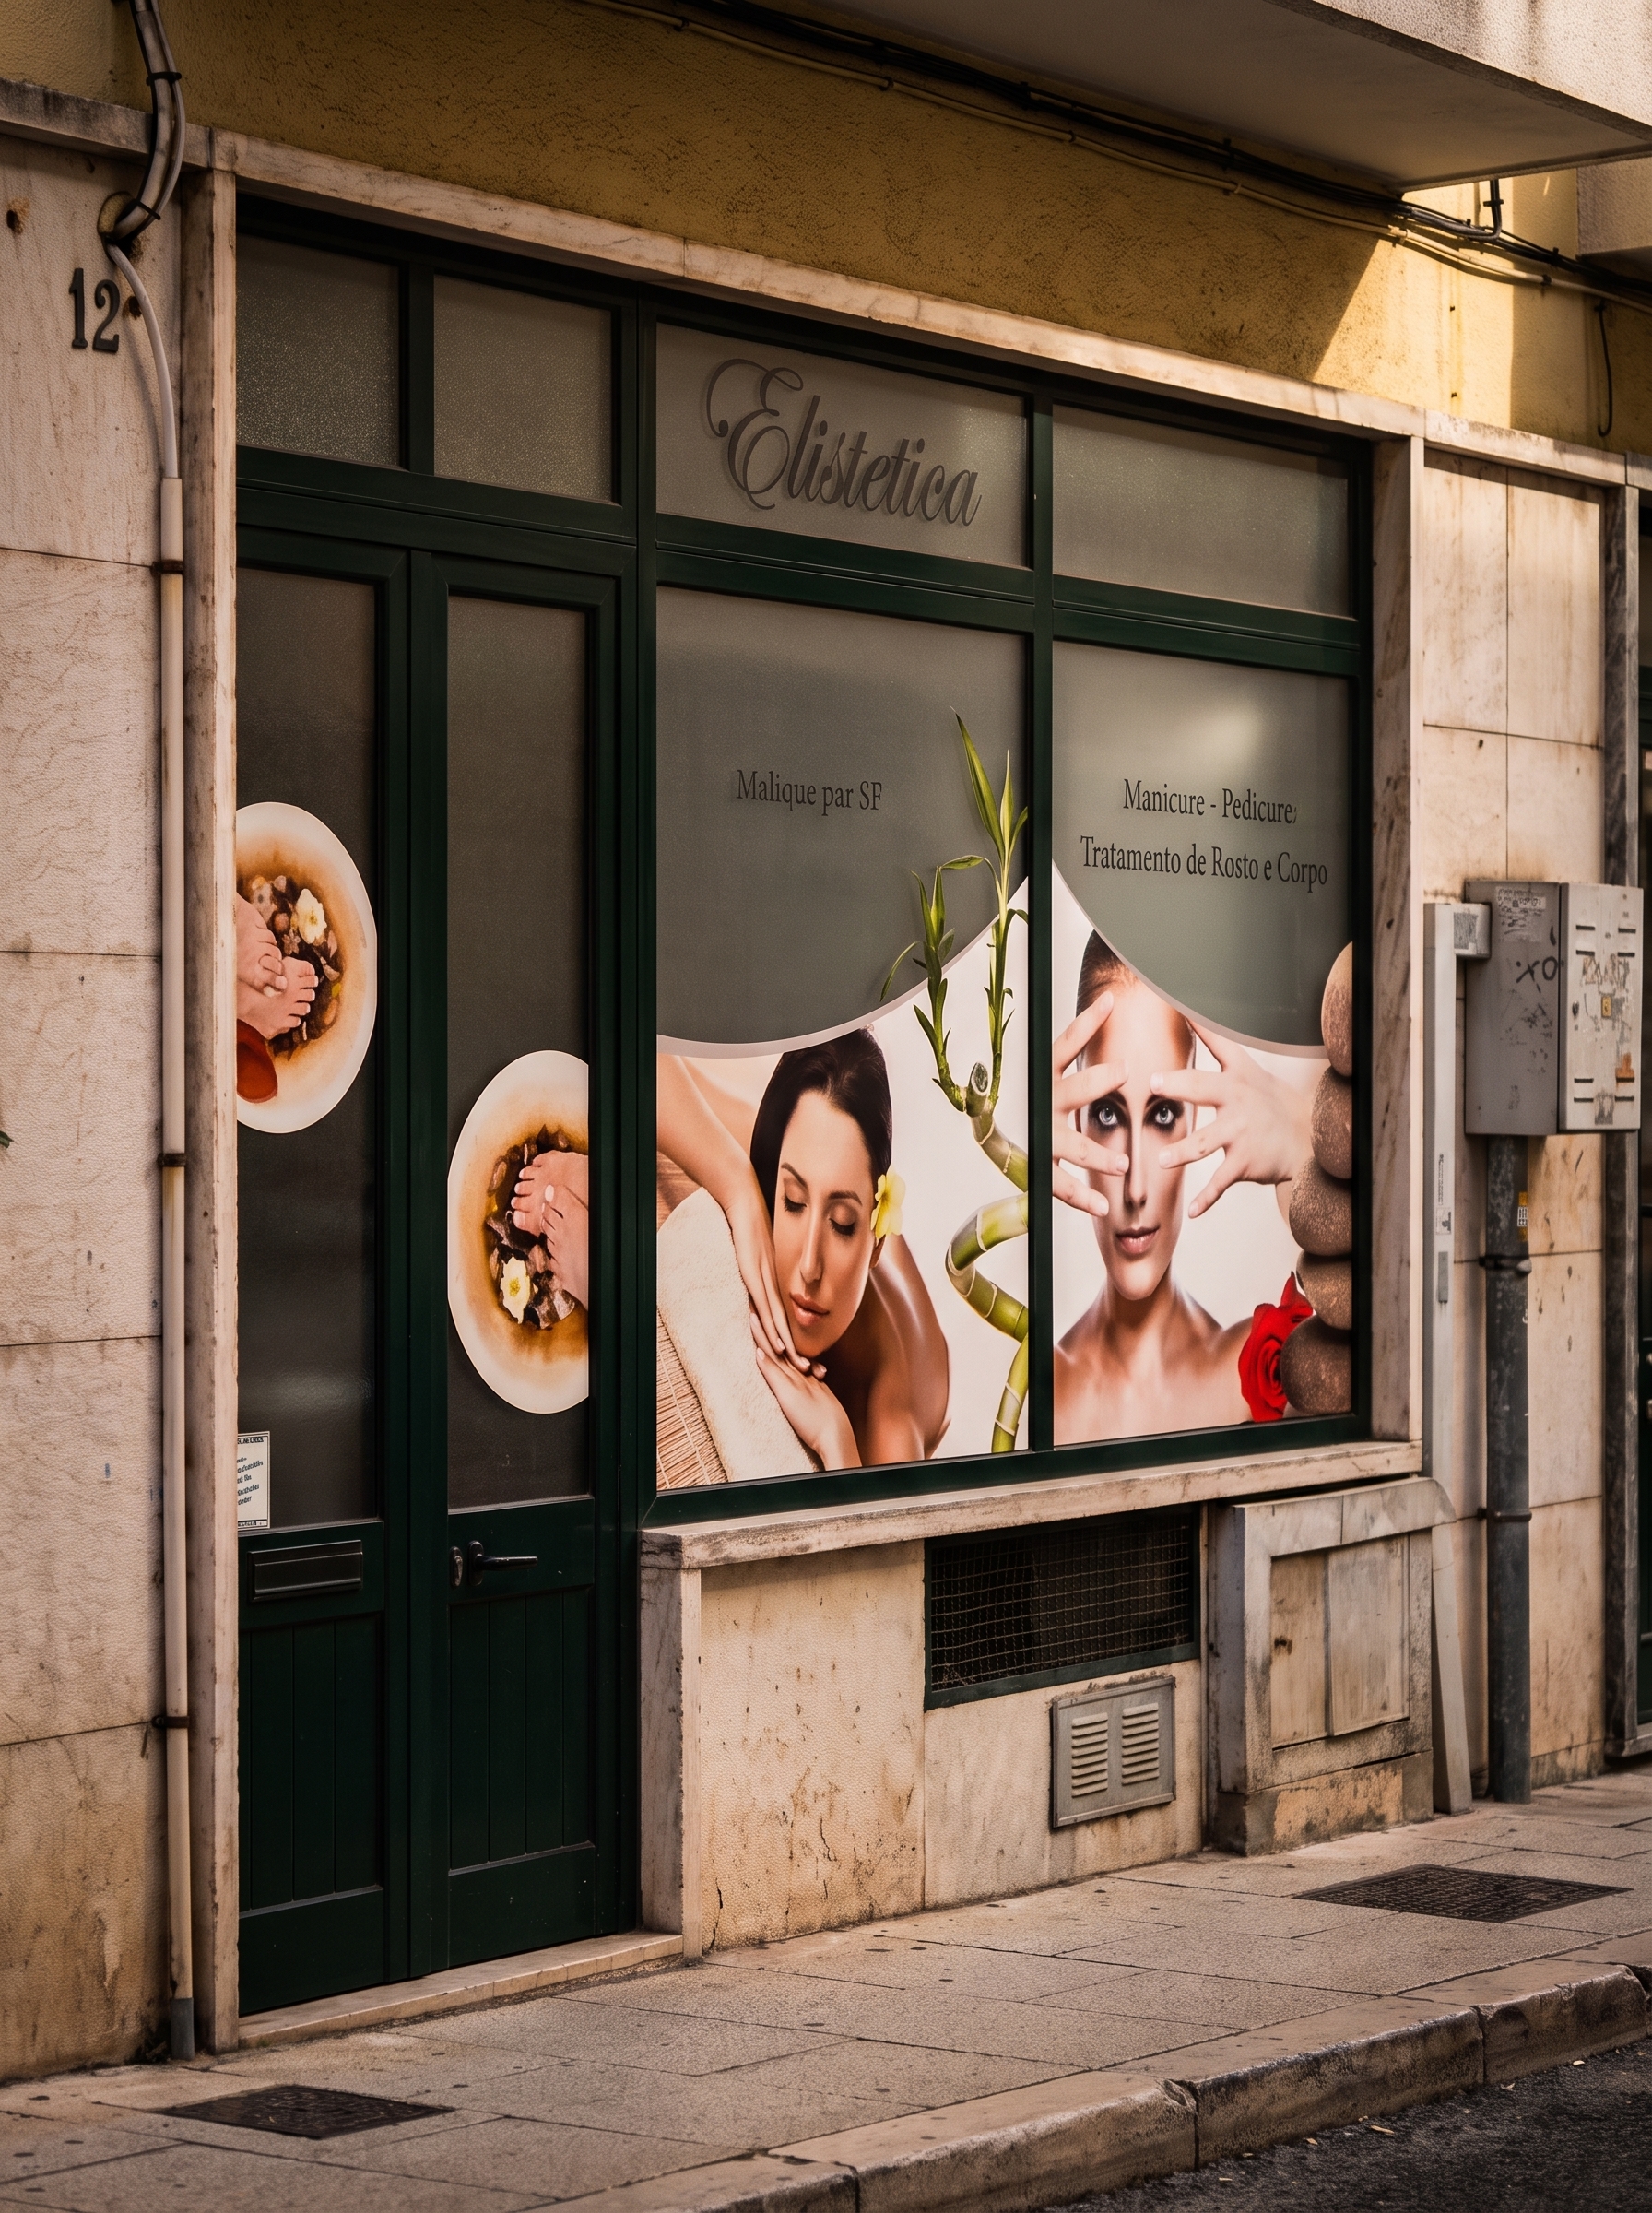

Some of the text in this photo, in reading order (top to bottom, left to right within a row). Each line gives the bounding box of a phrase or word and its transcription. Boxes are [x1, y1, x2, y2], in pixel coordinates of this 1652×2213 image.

[68, 267, 121, 355] 12
[706, 358, 983, 527] Elistetica
[736, 769, 882, 817] Malique par SF
[1123, 778, 1206, 816] Manicure
[1080, 834, 1328, 893] Tratamento de Rosto e Corpo
